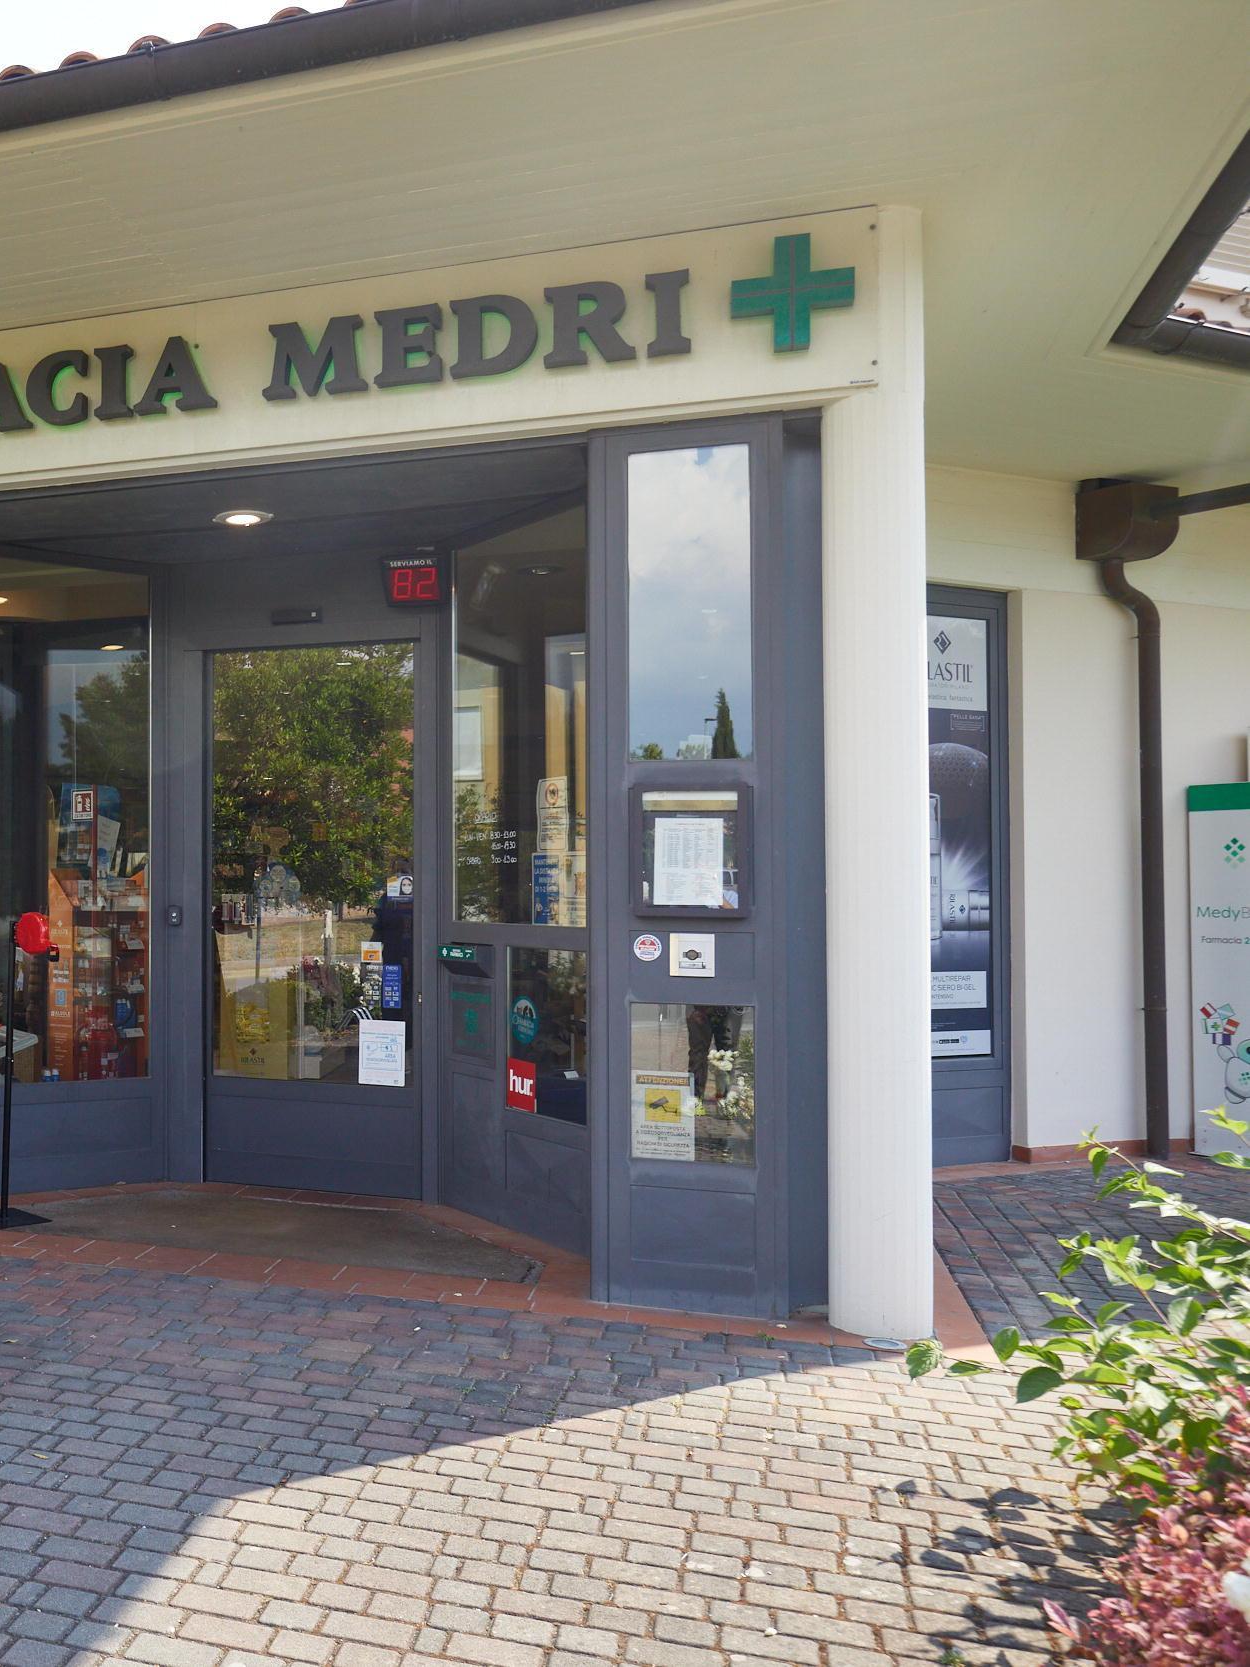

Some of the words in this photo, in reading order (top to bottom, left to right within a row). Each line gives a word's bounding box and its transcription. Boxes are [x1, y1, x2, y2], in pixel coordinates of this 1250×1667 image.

[262, 268, 691, 402] MEDRI
[389, 560, 425, 568] SERVIAMO
[393, 567, 437, 599] 82
[927, 660, 975, 683] LASTIL
[1201, 935, 1242, 945] Farmacia
